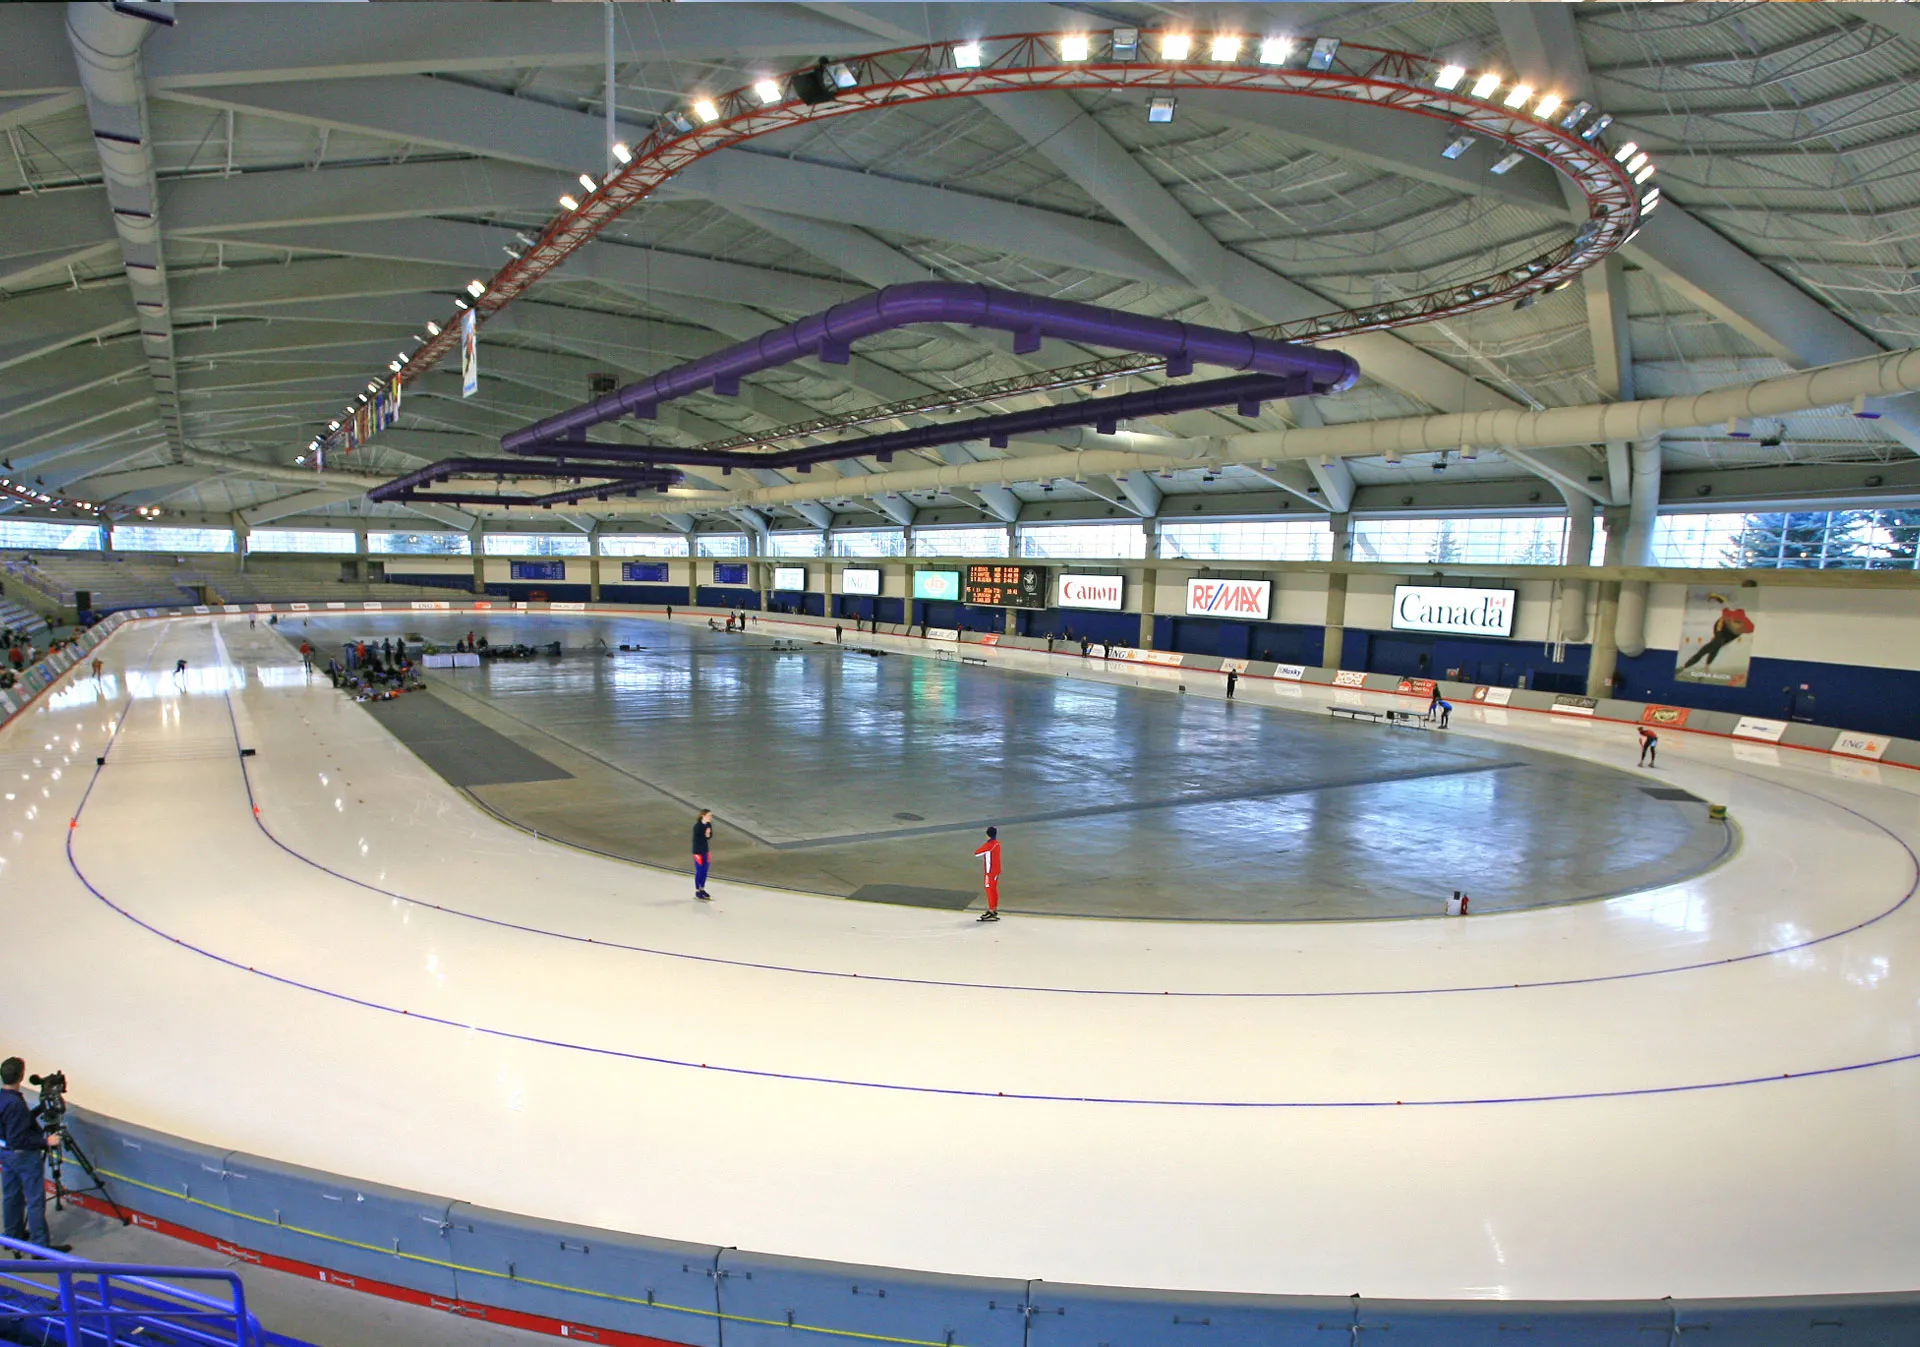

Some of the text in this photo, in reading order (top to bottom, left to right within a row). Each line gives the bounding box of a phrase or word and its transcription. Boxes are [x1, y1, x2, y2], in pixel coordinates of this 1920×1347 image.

[1064, 581, 1118, 601] Canon
[1192, 583, 1263, 613] RE/MAX
[1400, 593, 1504, 628] Canada
[1108, 648, 1127, 659] ING
[1841, 739, 1865, 749] ING
